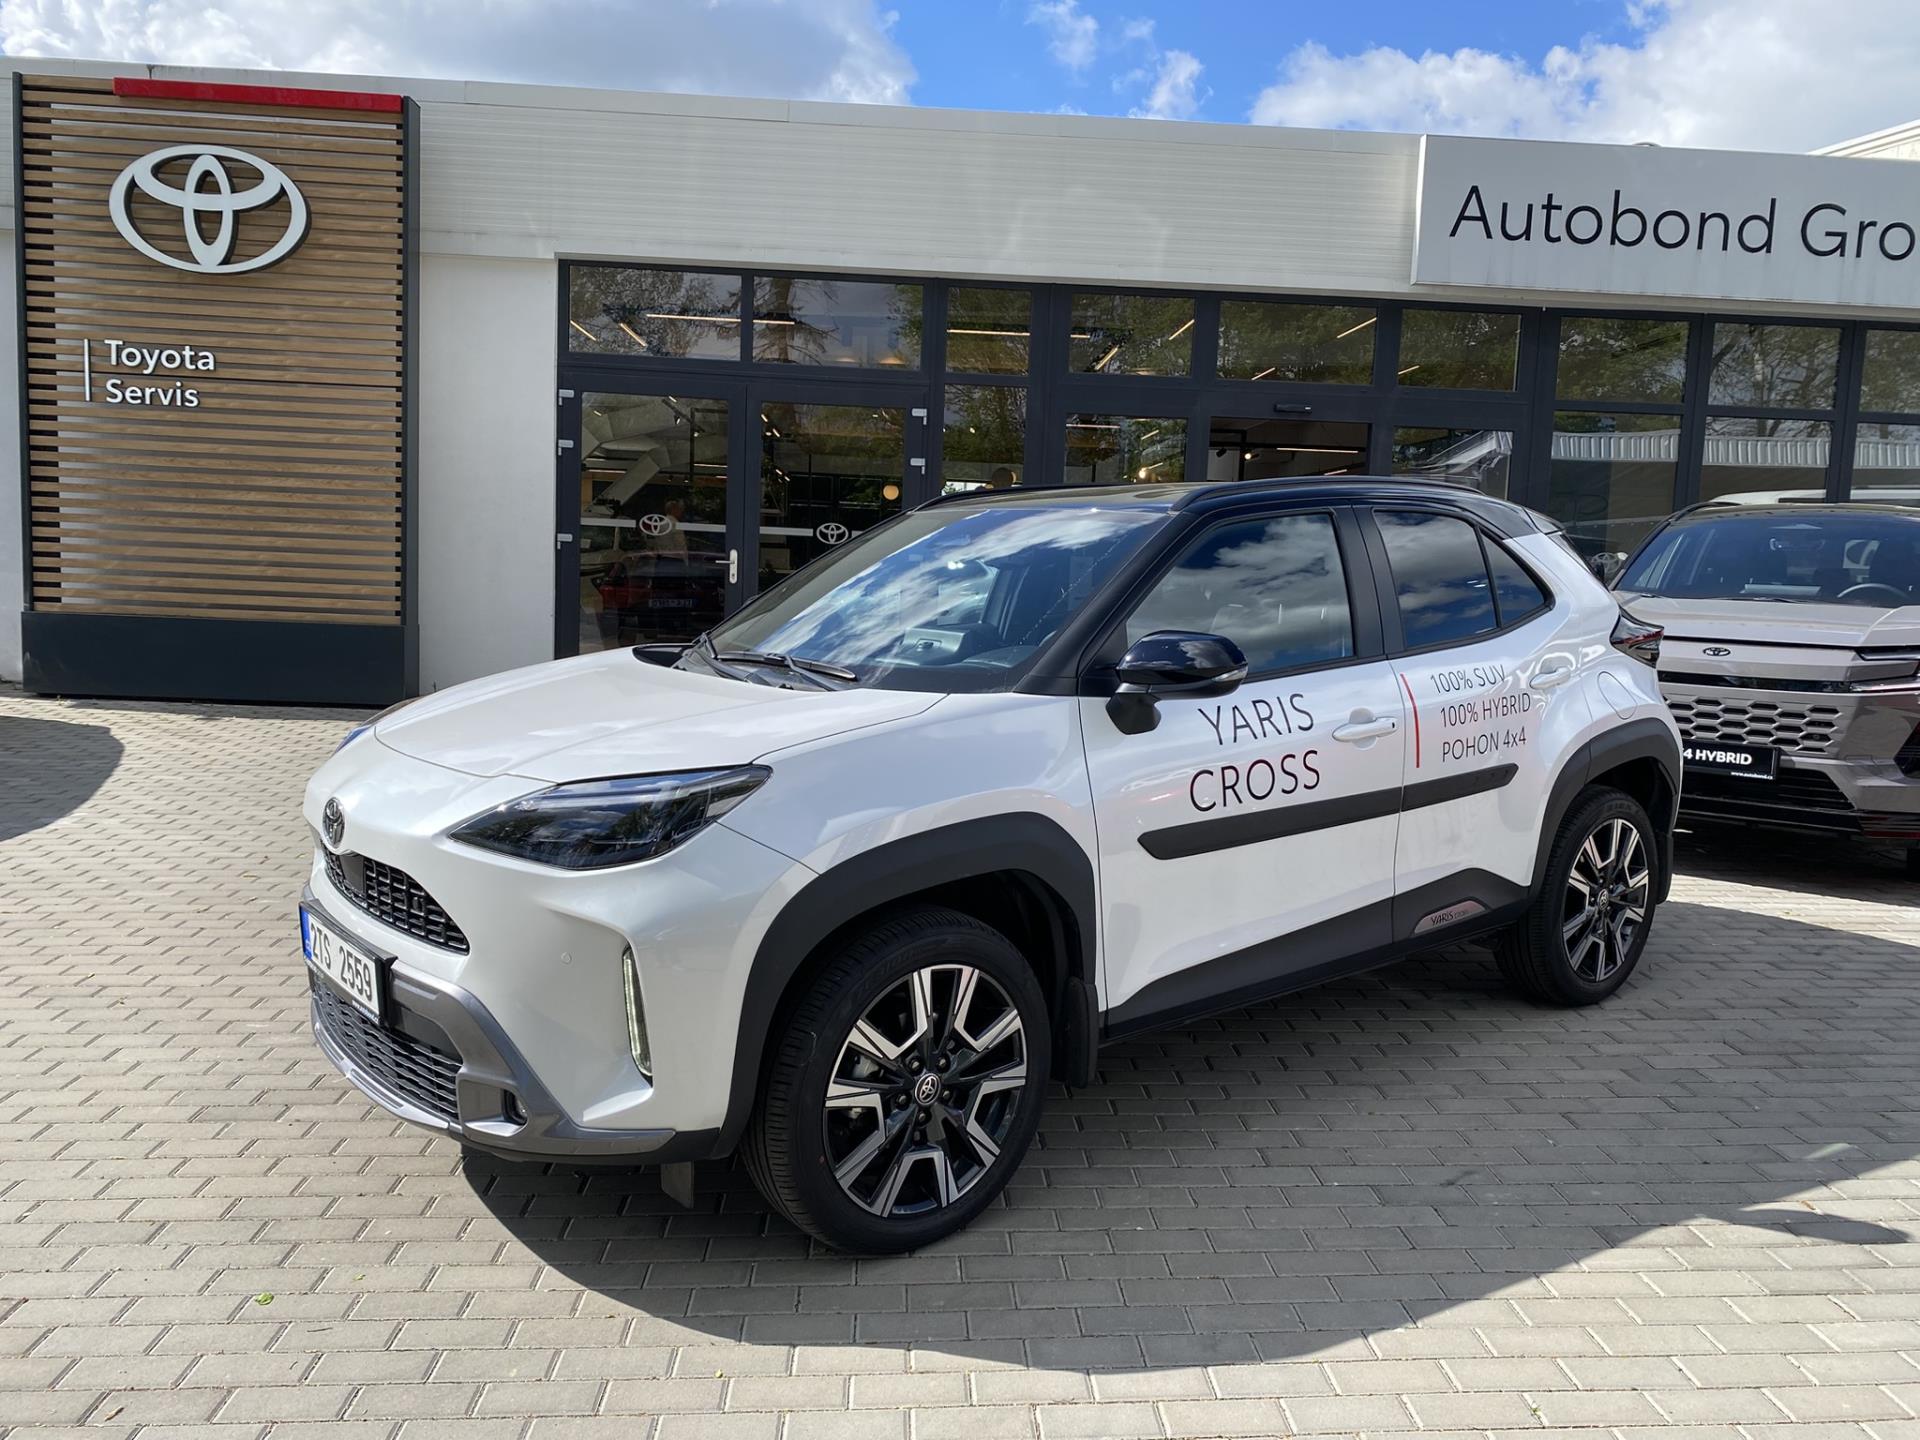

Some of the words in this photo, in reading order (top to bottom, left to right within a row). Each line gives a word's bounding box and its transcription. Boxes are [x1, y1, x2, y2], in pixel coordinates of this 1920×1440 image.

[1449, 184, 1777, 254] Autobond
[1799, 202, 1917, 262] Gro
[104, 339, 216, 375] Toyota
[105, 378, 200, 408] Servis
[1430, 671, 1474, 694] 100%
[1473, 664, 1506, 688] SUV
[1197, 693, 1314, 746] YARIS
[1440, 701, 1479, 728] 100%
[1482, 692, 1532, 721] HYBRID
[1442, 731, 1500, 763] POHON
[1502, 725, 1527, 749] 4x4
[1682, 747, 1693, 760] 4
[1695, 748, 1753, 766] HYBRID
[1189, 749, 1320, 813] CROSS
[310, 922, 332, 971] 2TS
[339, 945, 373, 1003] 2559
